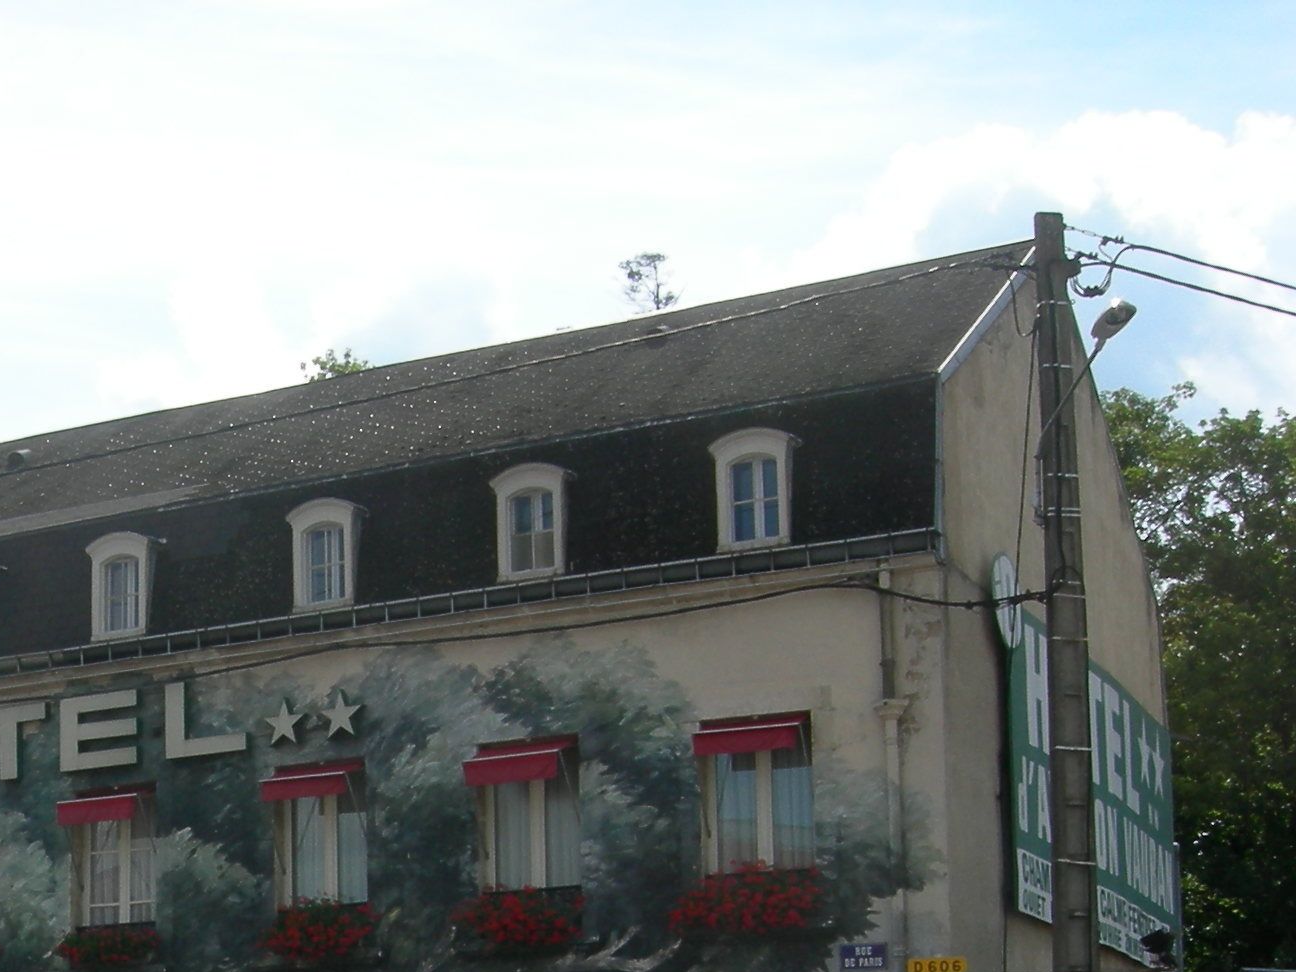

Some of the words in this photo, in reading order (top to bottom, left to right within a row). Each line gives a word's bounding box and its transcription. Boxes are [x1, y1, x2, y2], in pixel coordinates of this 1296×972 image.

[1024, 624, 1140, 815] HTEL
[1123, 816, 1174, 915] VAUBAN
[855, 946, 872, 956] RUE
[844, 958, 855, 968] DE
[859, 957, 883, 967] PARIS
[914, 961, 922, 972] D
[928, 960, 962, 972] 606
